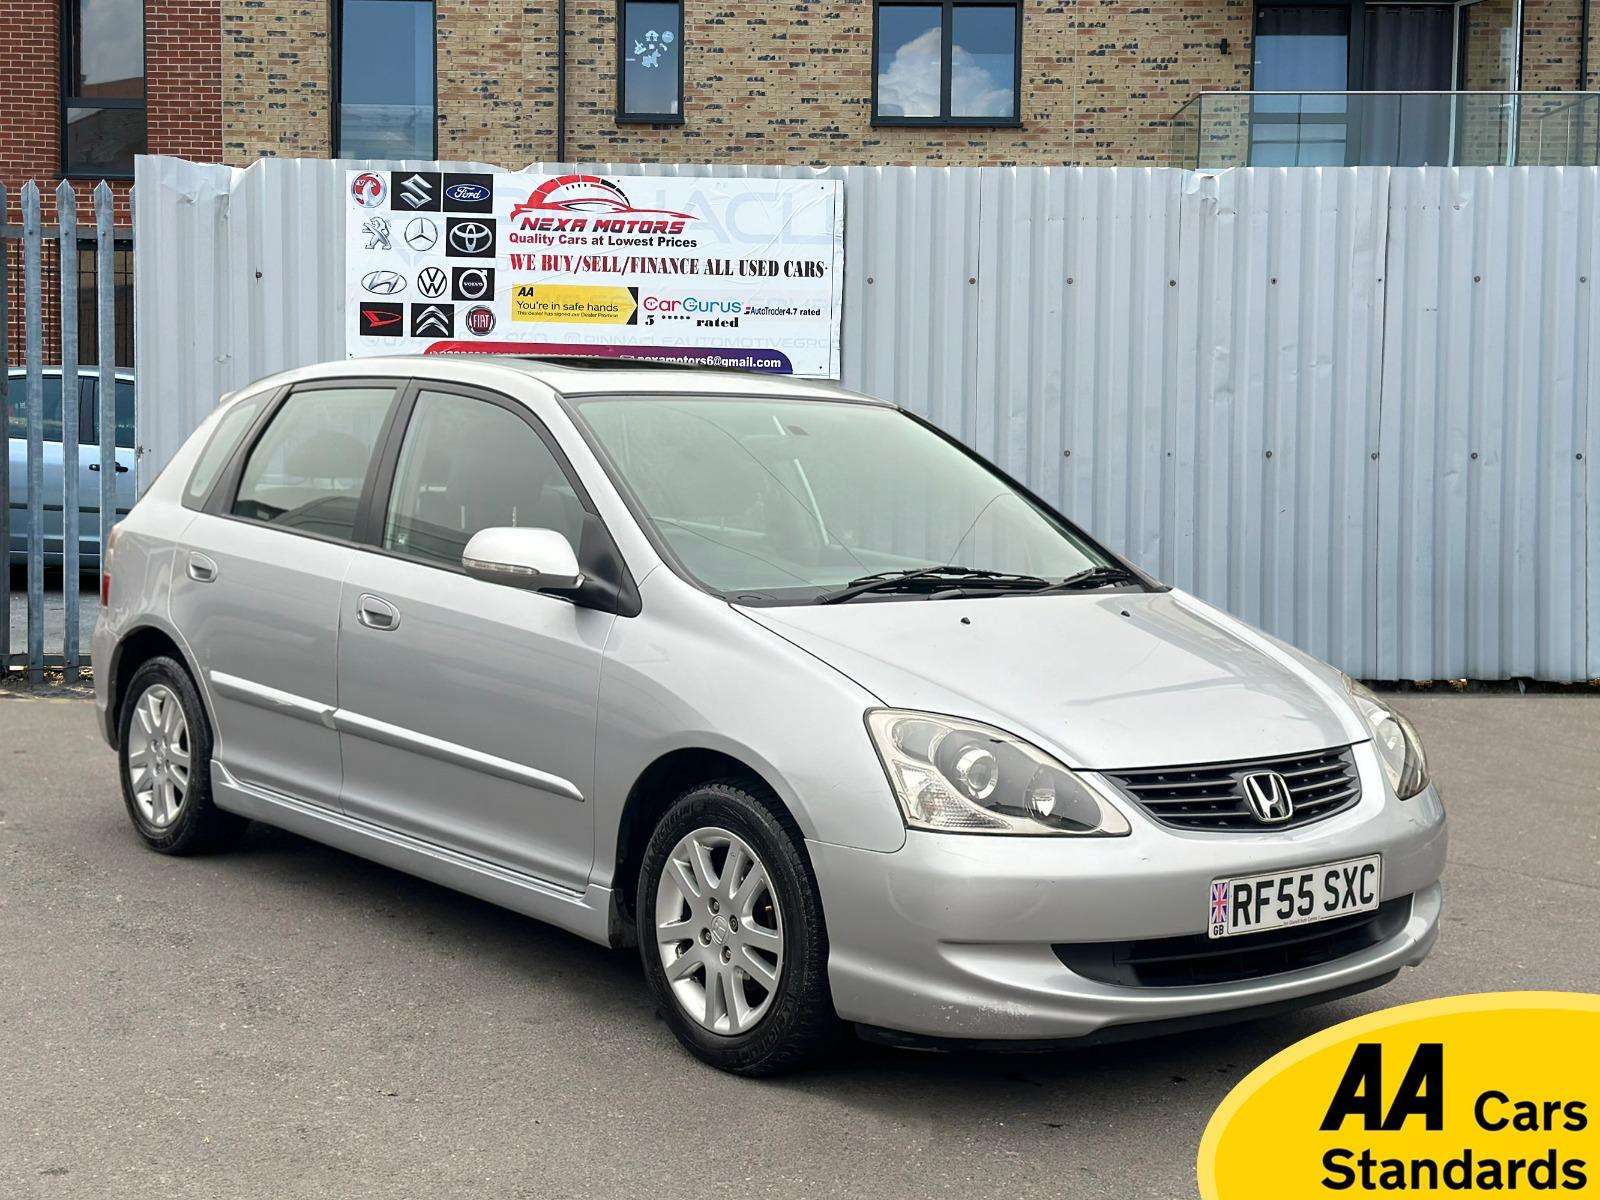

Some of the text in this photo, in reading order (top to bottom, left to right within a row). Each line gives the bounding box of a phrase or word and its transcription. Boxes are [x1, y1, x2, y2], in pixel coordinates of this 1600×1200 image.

[454, 186, 481, 200] Ford
[520, 217, 686, 235] NEXA MOTORS
[509, 232, 697, 248] Quality Cars at Lowest Prices
[510, 253, 824, 279] WE BUY/SELL/FINANCE ALL USED CARS
[517, 286, 534, 297] AA
[516, 300, 619, 312] You're in safe hands
[643, 296, 742, 313] CarGurus
[799, 308, 821, 316] rated
[472, 314, 490, 325] FIAT
[645, 315, 739, 328] 5 rated
[1232, 863, 1375, 928] RF55 SXC
[1213, 924, 1224, 936] GB
